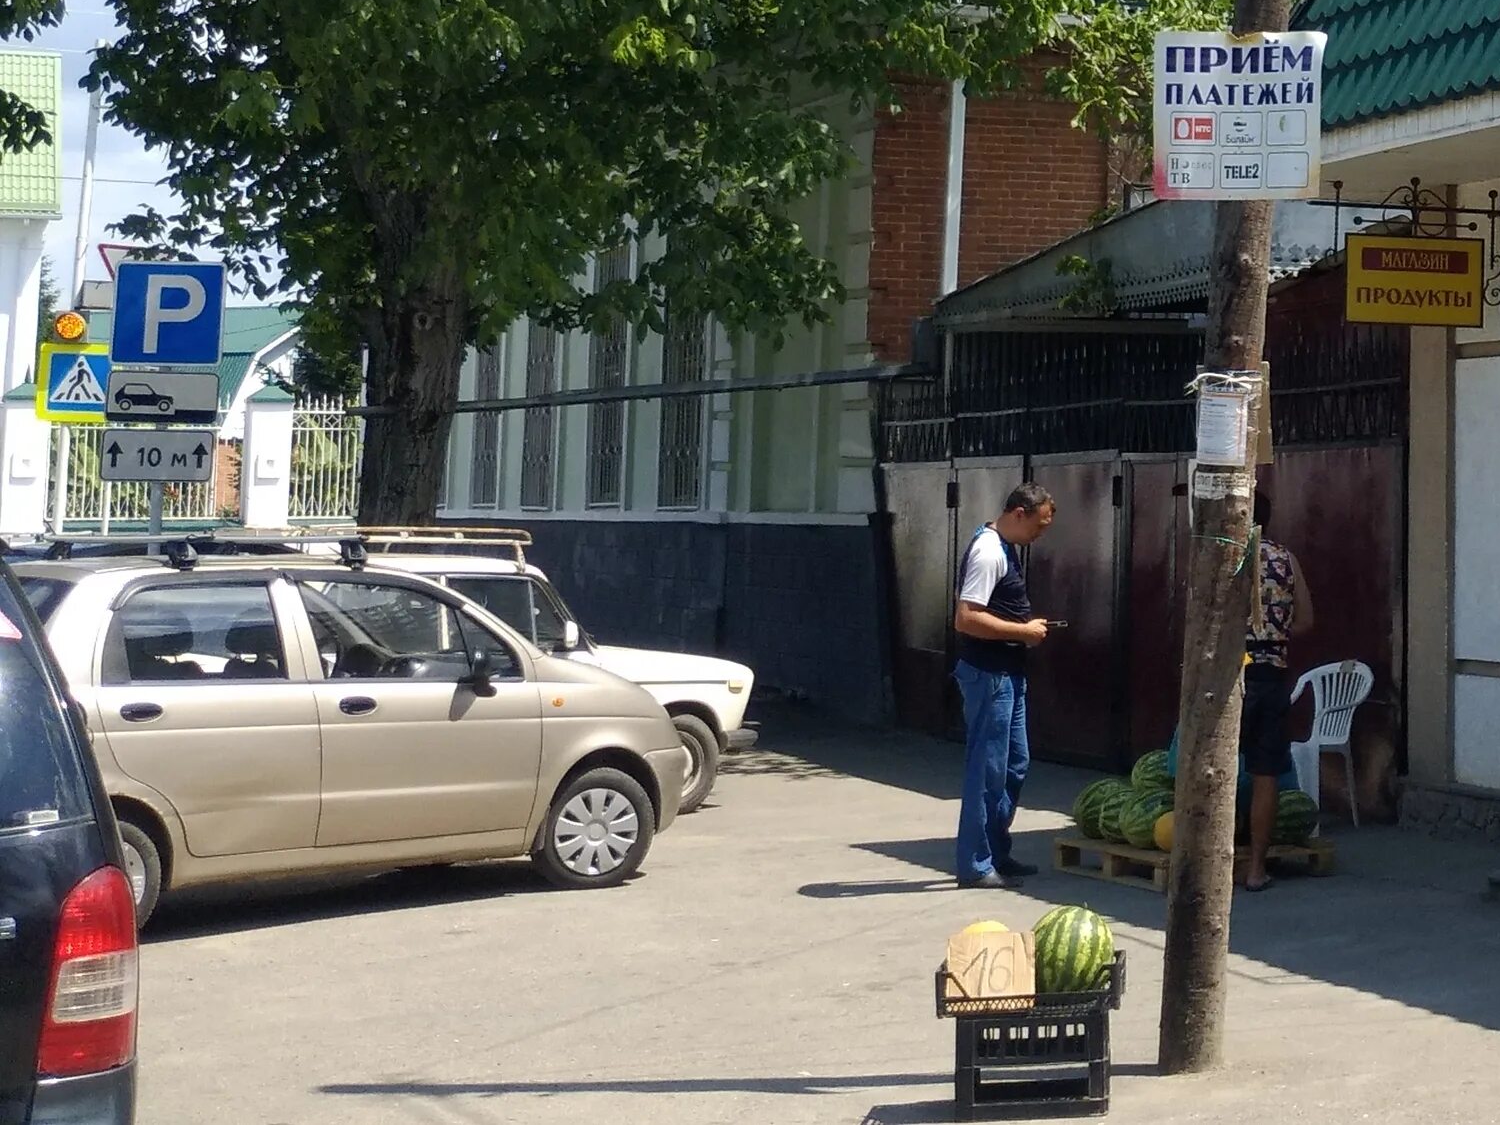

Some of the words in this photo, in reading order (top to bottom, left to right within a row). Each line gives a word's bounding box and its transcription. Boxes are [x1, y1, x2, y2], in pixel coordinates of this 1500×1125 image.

[1165, 39, 1314, 74] ПРИЁМ
[1165, 77, 1315, 106] ПЛАТЕЖЕЙ
[1224, 163, 1259, 179] TELE2
[1381, 251, 1449, 270] МАГАЗИН
[1356, 286, 1472, 308] ПРОДУКТЫ
[142, 274, 206, 354] P
[137, 447, 162, 467] 10
[962, 946, 1014, 996] 16
